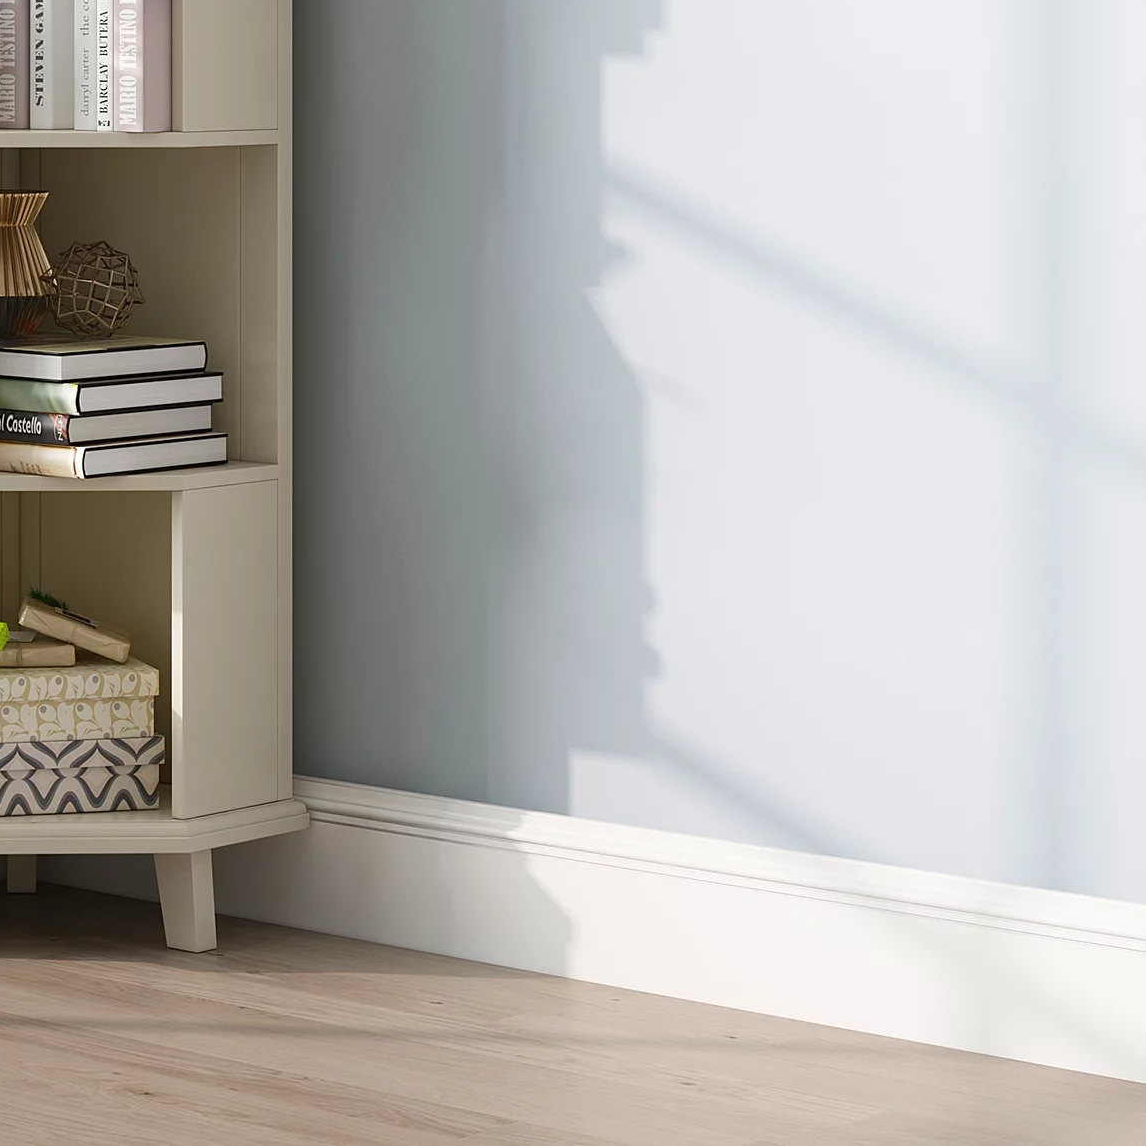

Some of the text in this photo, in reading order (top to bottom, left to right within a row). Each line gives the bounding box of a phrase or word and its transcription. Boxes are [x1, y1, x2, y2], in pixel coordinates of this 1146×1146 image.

[80, 15, 89, 36] the
[99, 11, 108, 56] BUTERA
[119, 9, 137, 70] TESTINO
[35, 38, 44, 106] STEVEN
[99, 62, 108, 114] BARCLAY
[80, 84, 90, 117] darryl
[119, 76, 137, 126] MARIO
[6, 415, 42, 435] Costello
